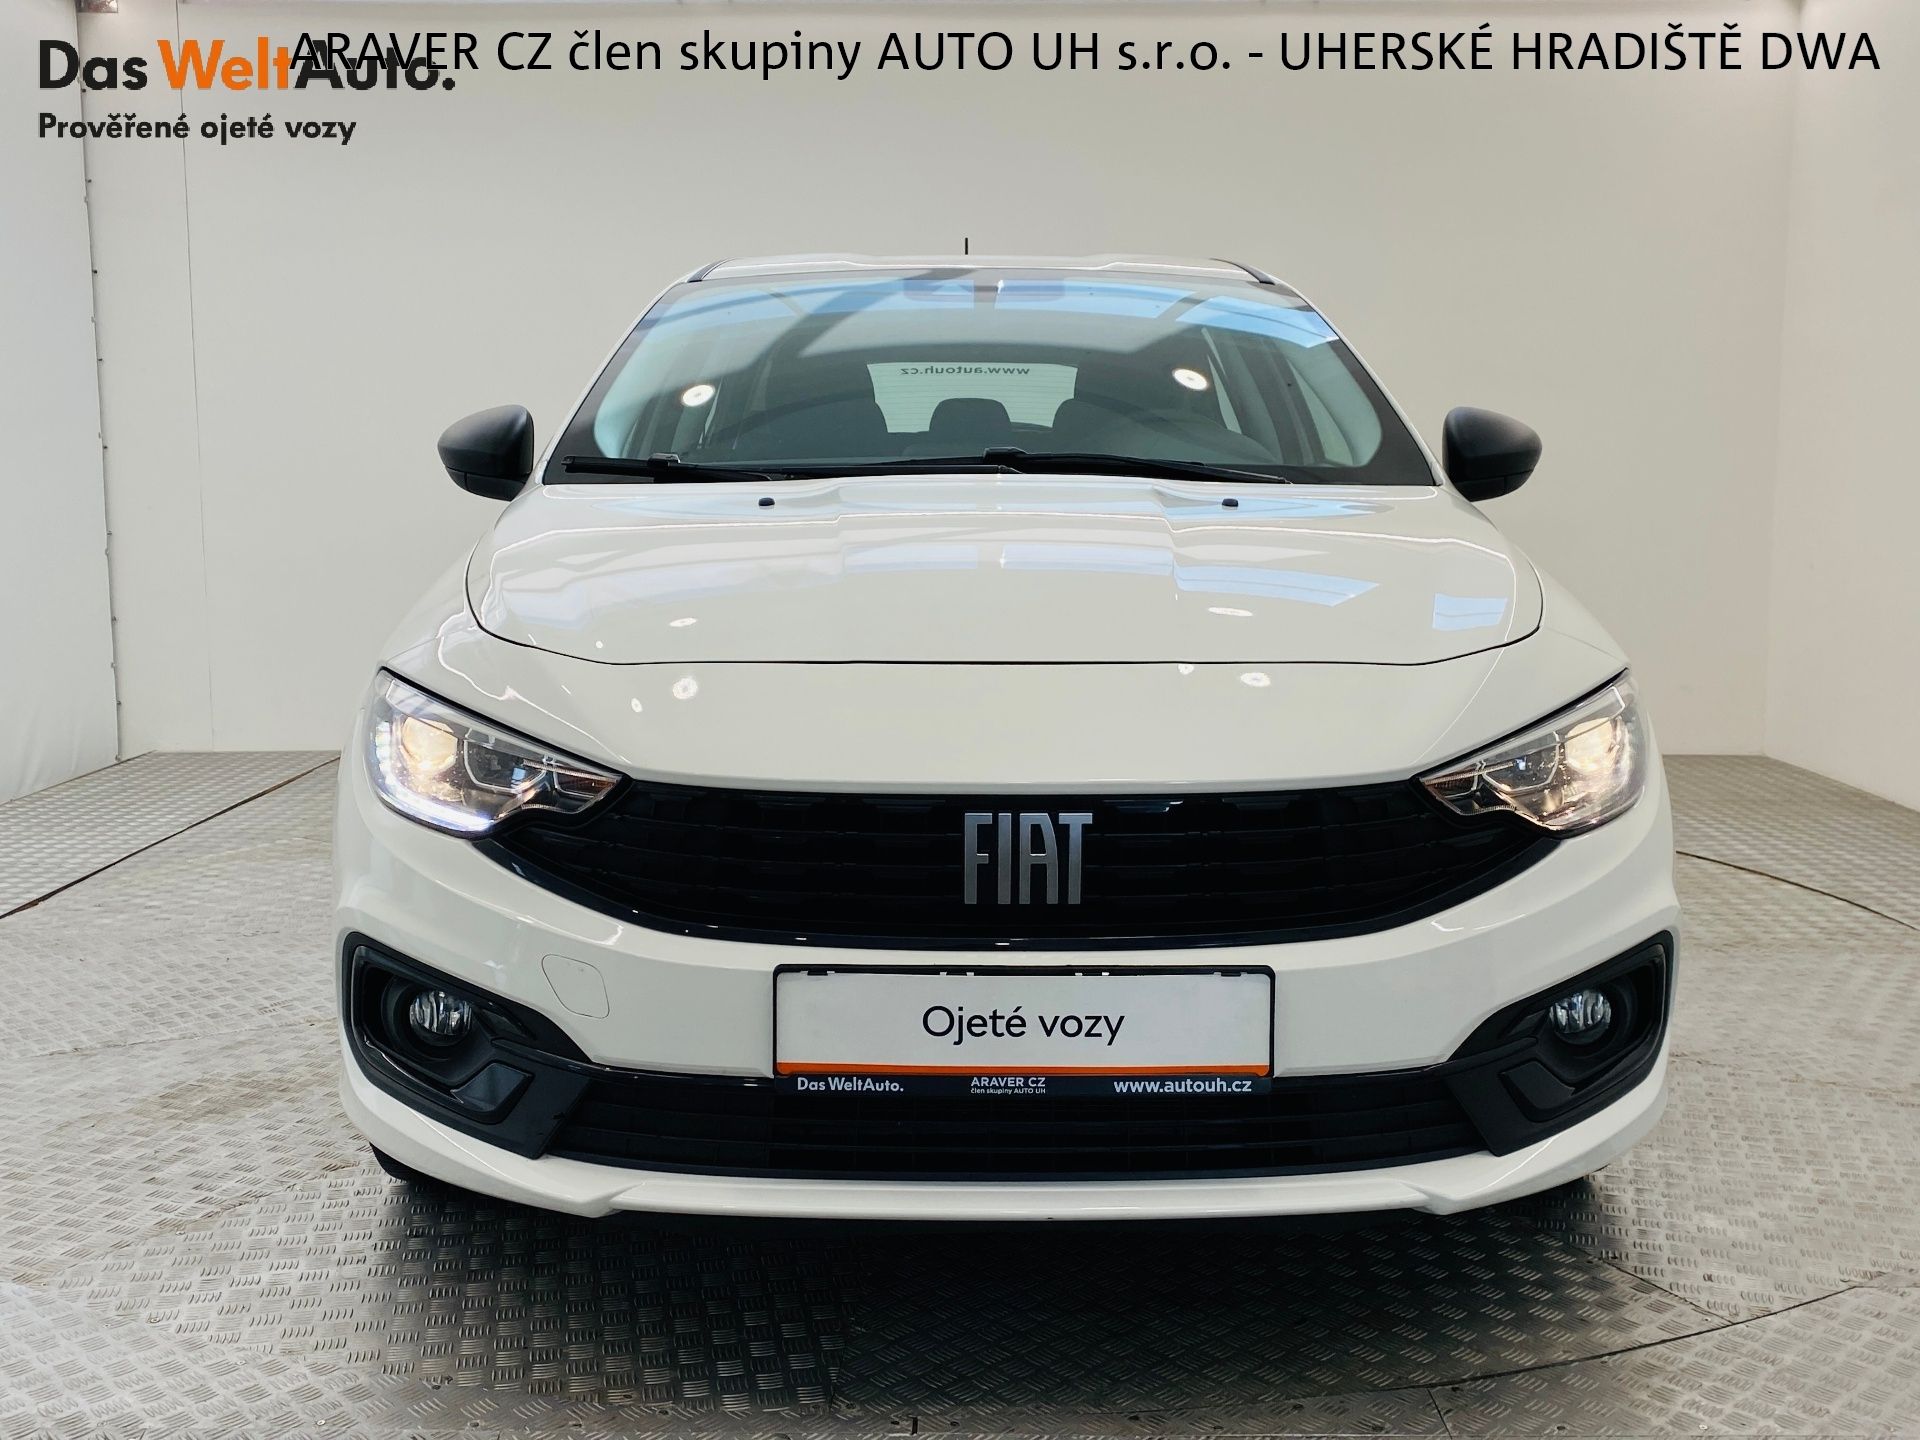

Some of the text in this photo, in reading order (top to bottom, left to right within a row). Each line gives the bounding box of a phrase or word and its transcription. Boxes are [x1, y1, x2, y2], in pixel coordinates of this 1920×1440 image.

[964, 812, 1093, 905] FIAT
[922, 1005, 1125, 1046] Ojeté vozy
[797, 1077, 826, 1091] Das
[970, 1076, 1046, 1087] ARAVER CZ
[1113, 1077, 1252, 1093] www.autouh.cz
[986, 1087, 1013, 1095] skupiny
